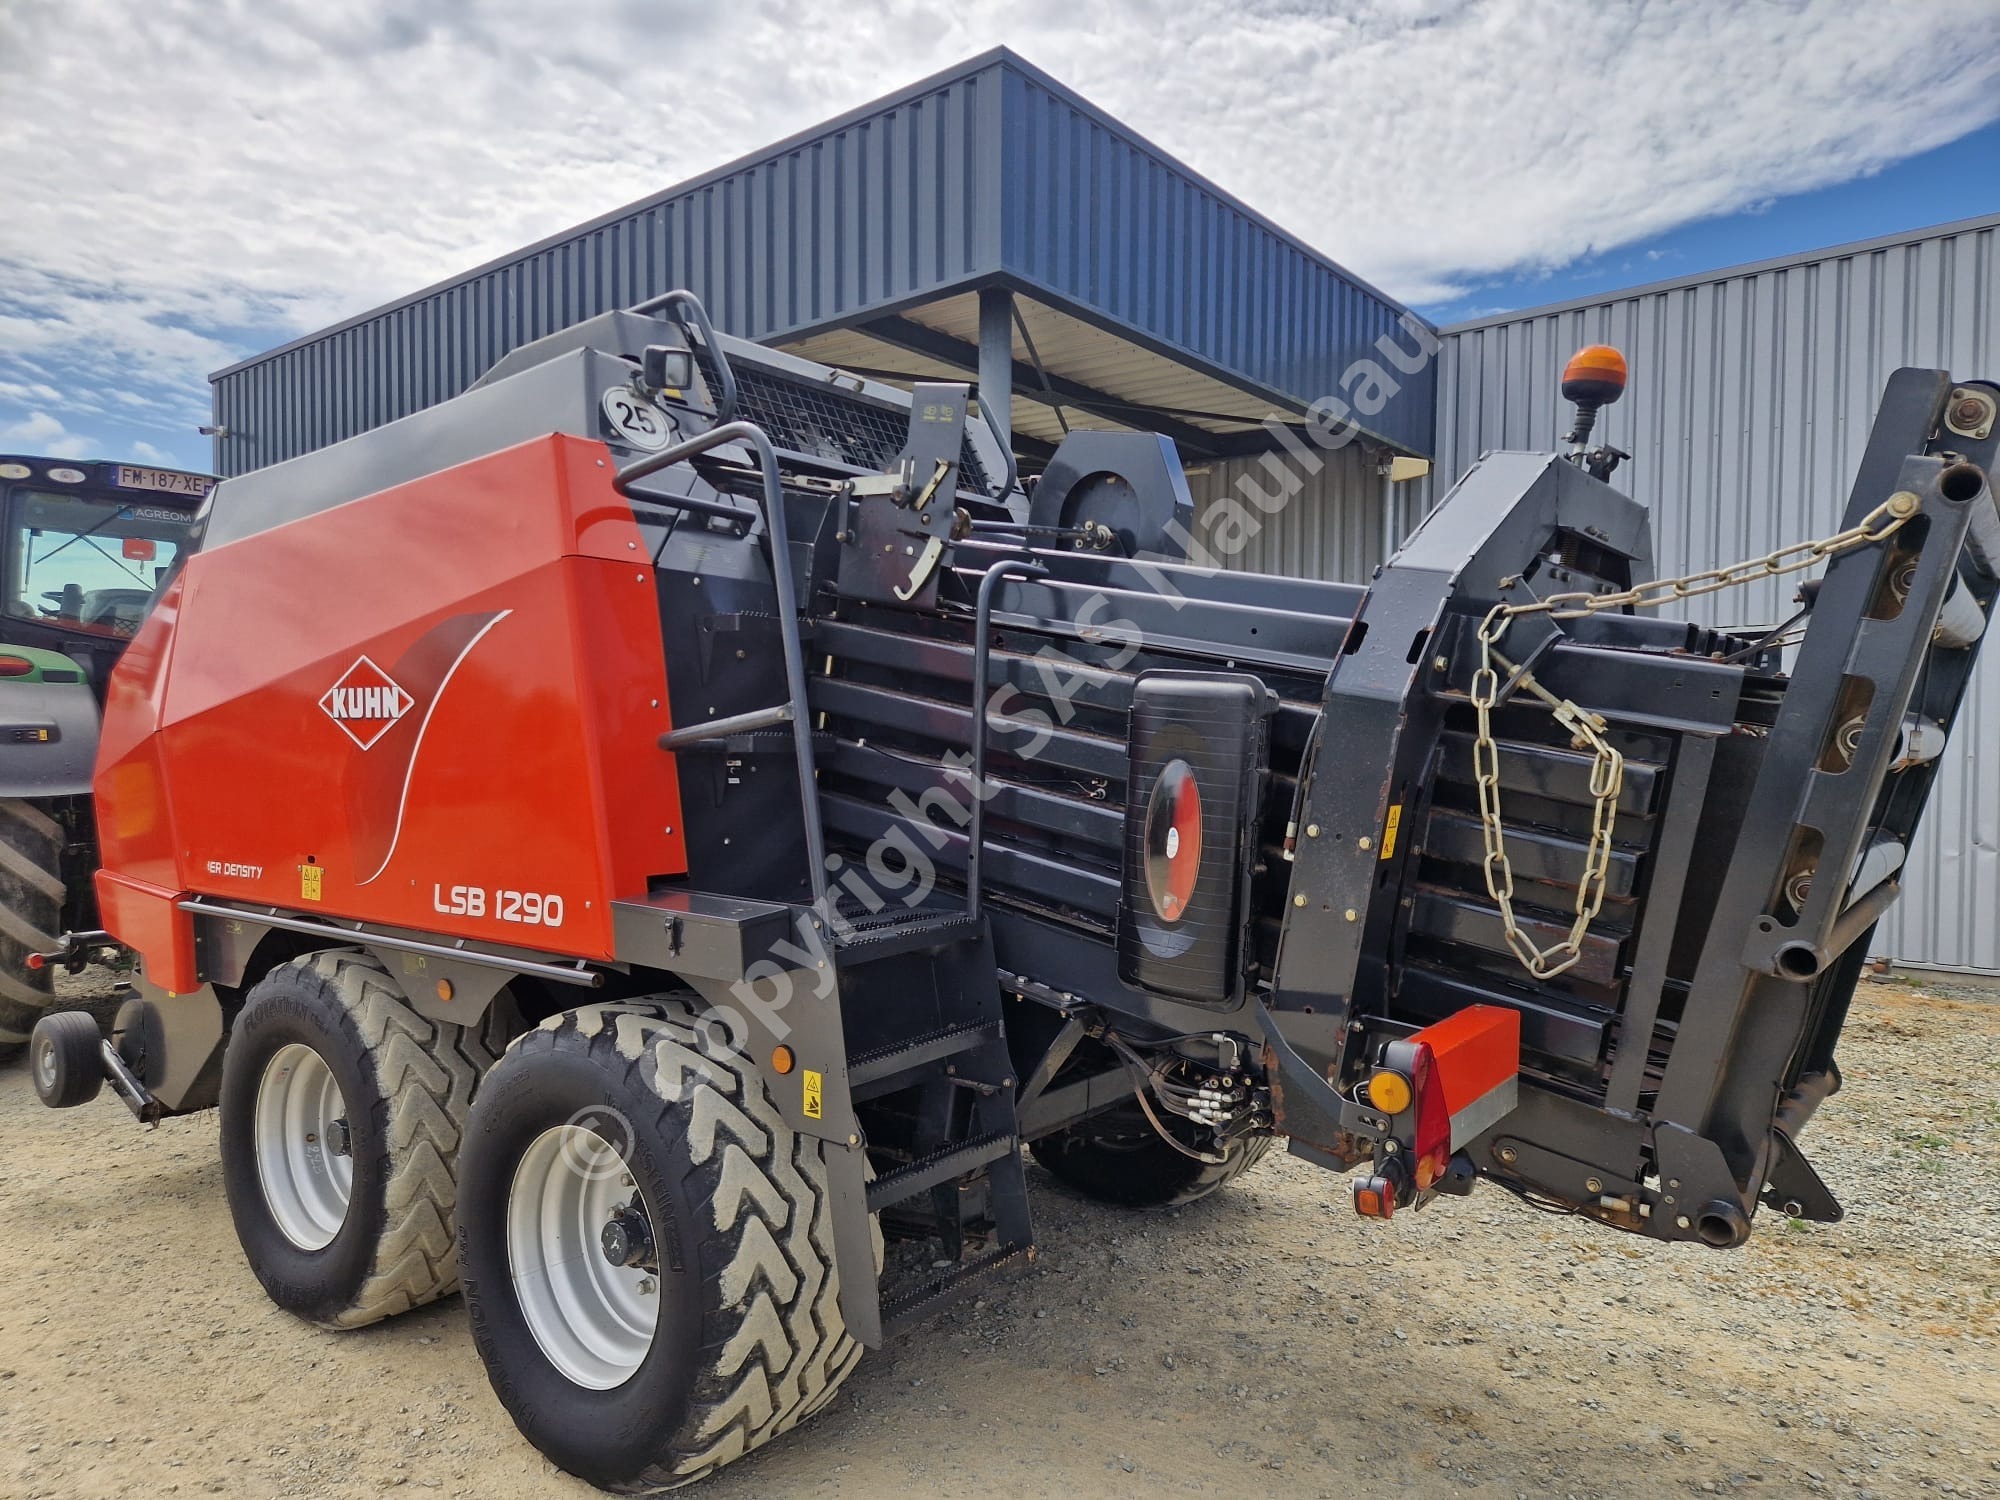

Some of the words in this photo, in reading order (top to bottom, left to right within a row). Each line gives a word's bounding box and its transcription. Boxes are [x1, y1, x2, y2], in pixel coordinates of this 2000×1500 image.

[616, 401, 657, 435] 25
[122, 468, 203, 493] FM-187-XE
[332, 686, 400, 719] KUHN
[223, 862, 263, 880] DENSITY
[434, 883, 486, 917] LSB
[495, 889, 564, 927] 1290
